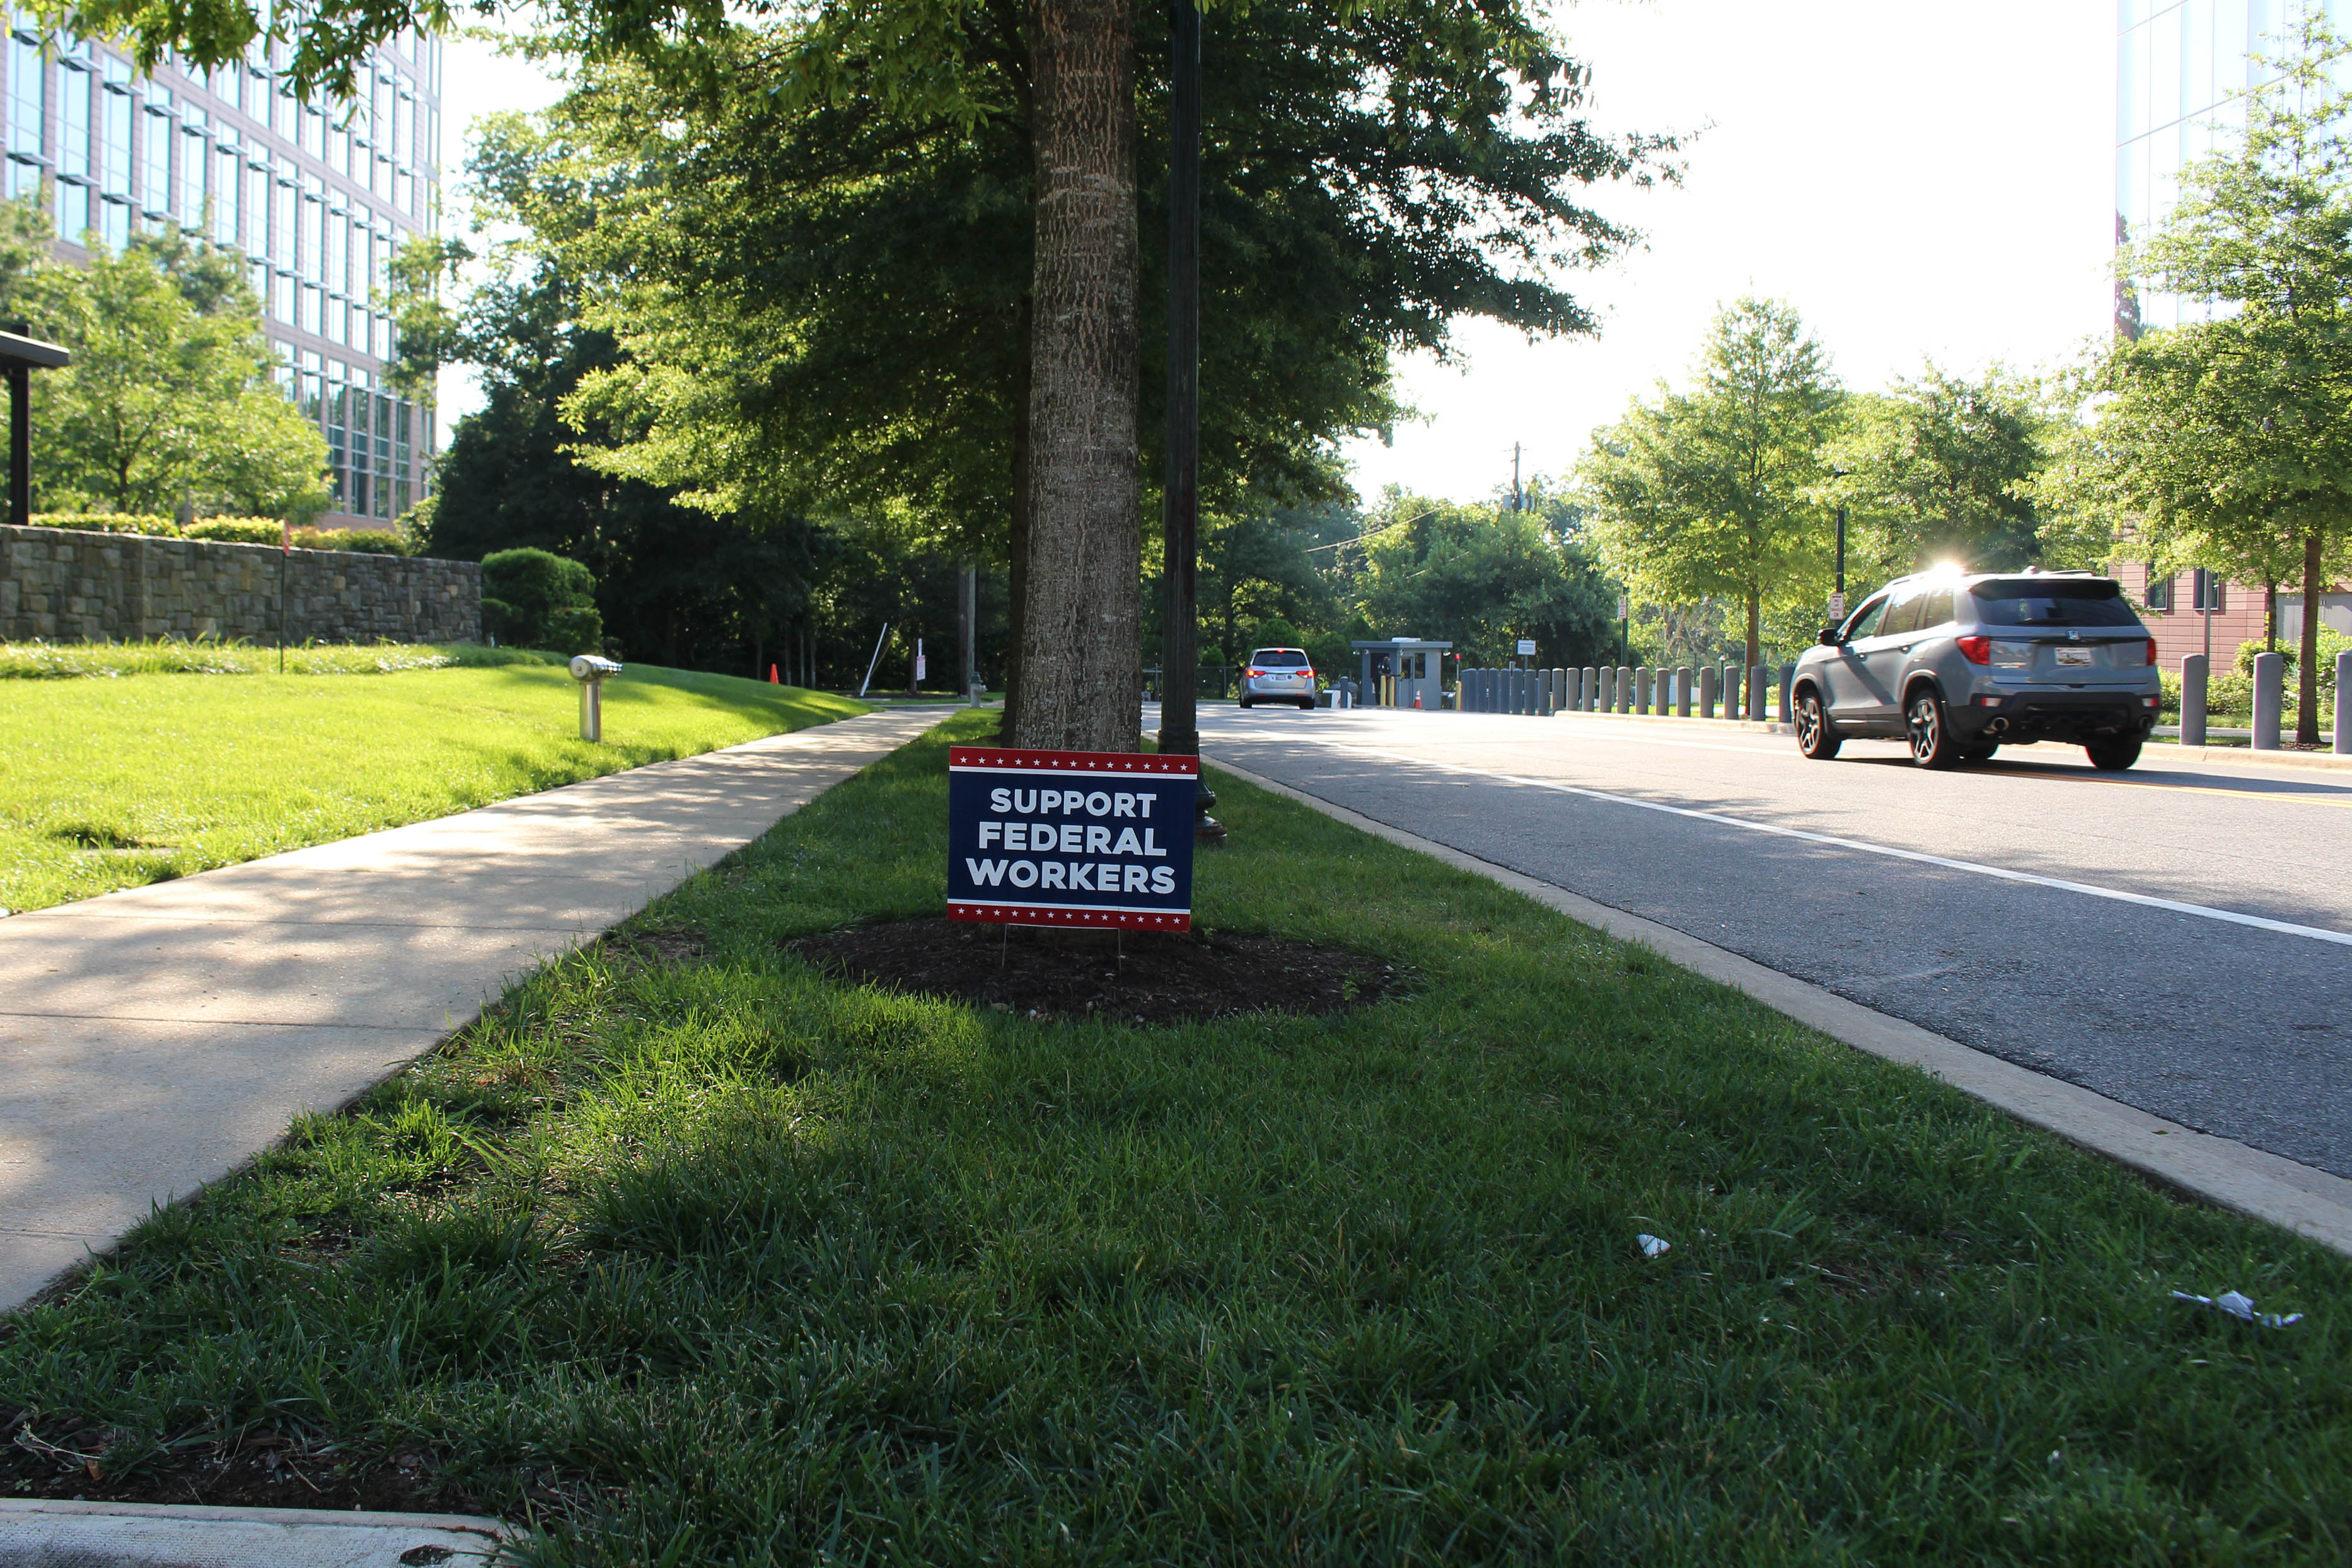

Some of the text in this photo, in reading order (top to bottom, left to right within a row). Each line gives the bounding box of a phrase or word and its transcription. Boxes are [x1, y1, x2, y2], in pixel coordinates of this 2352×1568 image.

[990, 788, 1157, 817] SUPPORT
[979, 821, 1167, 856] FEDERAL
[966, 858, 1175, 894] WORKERS
